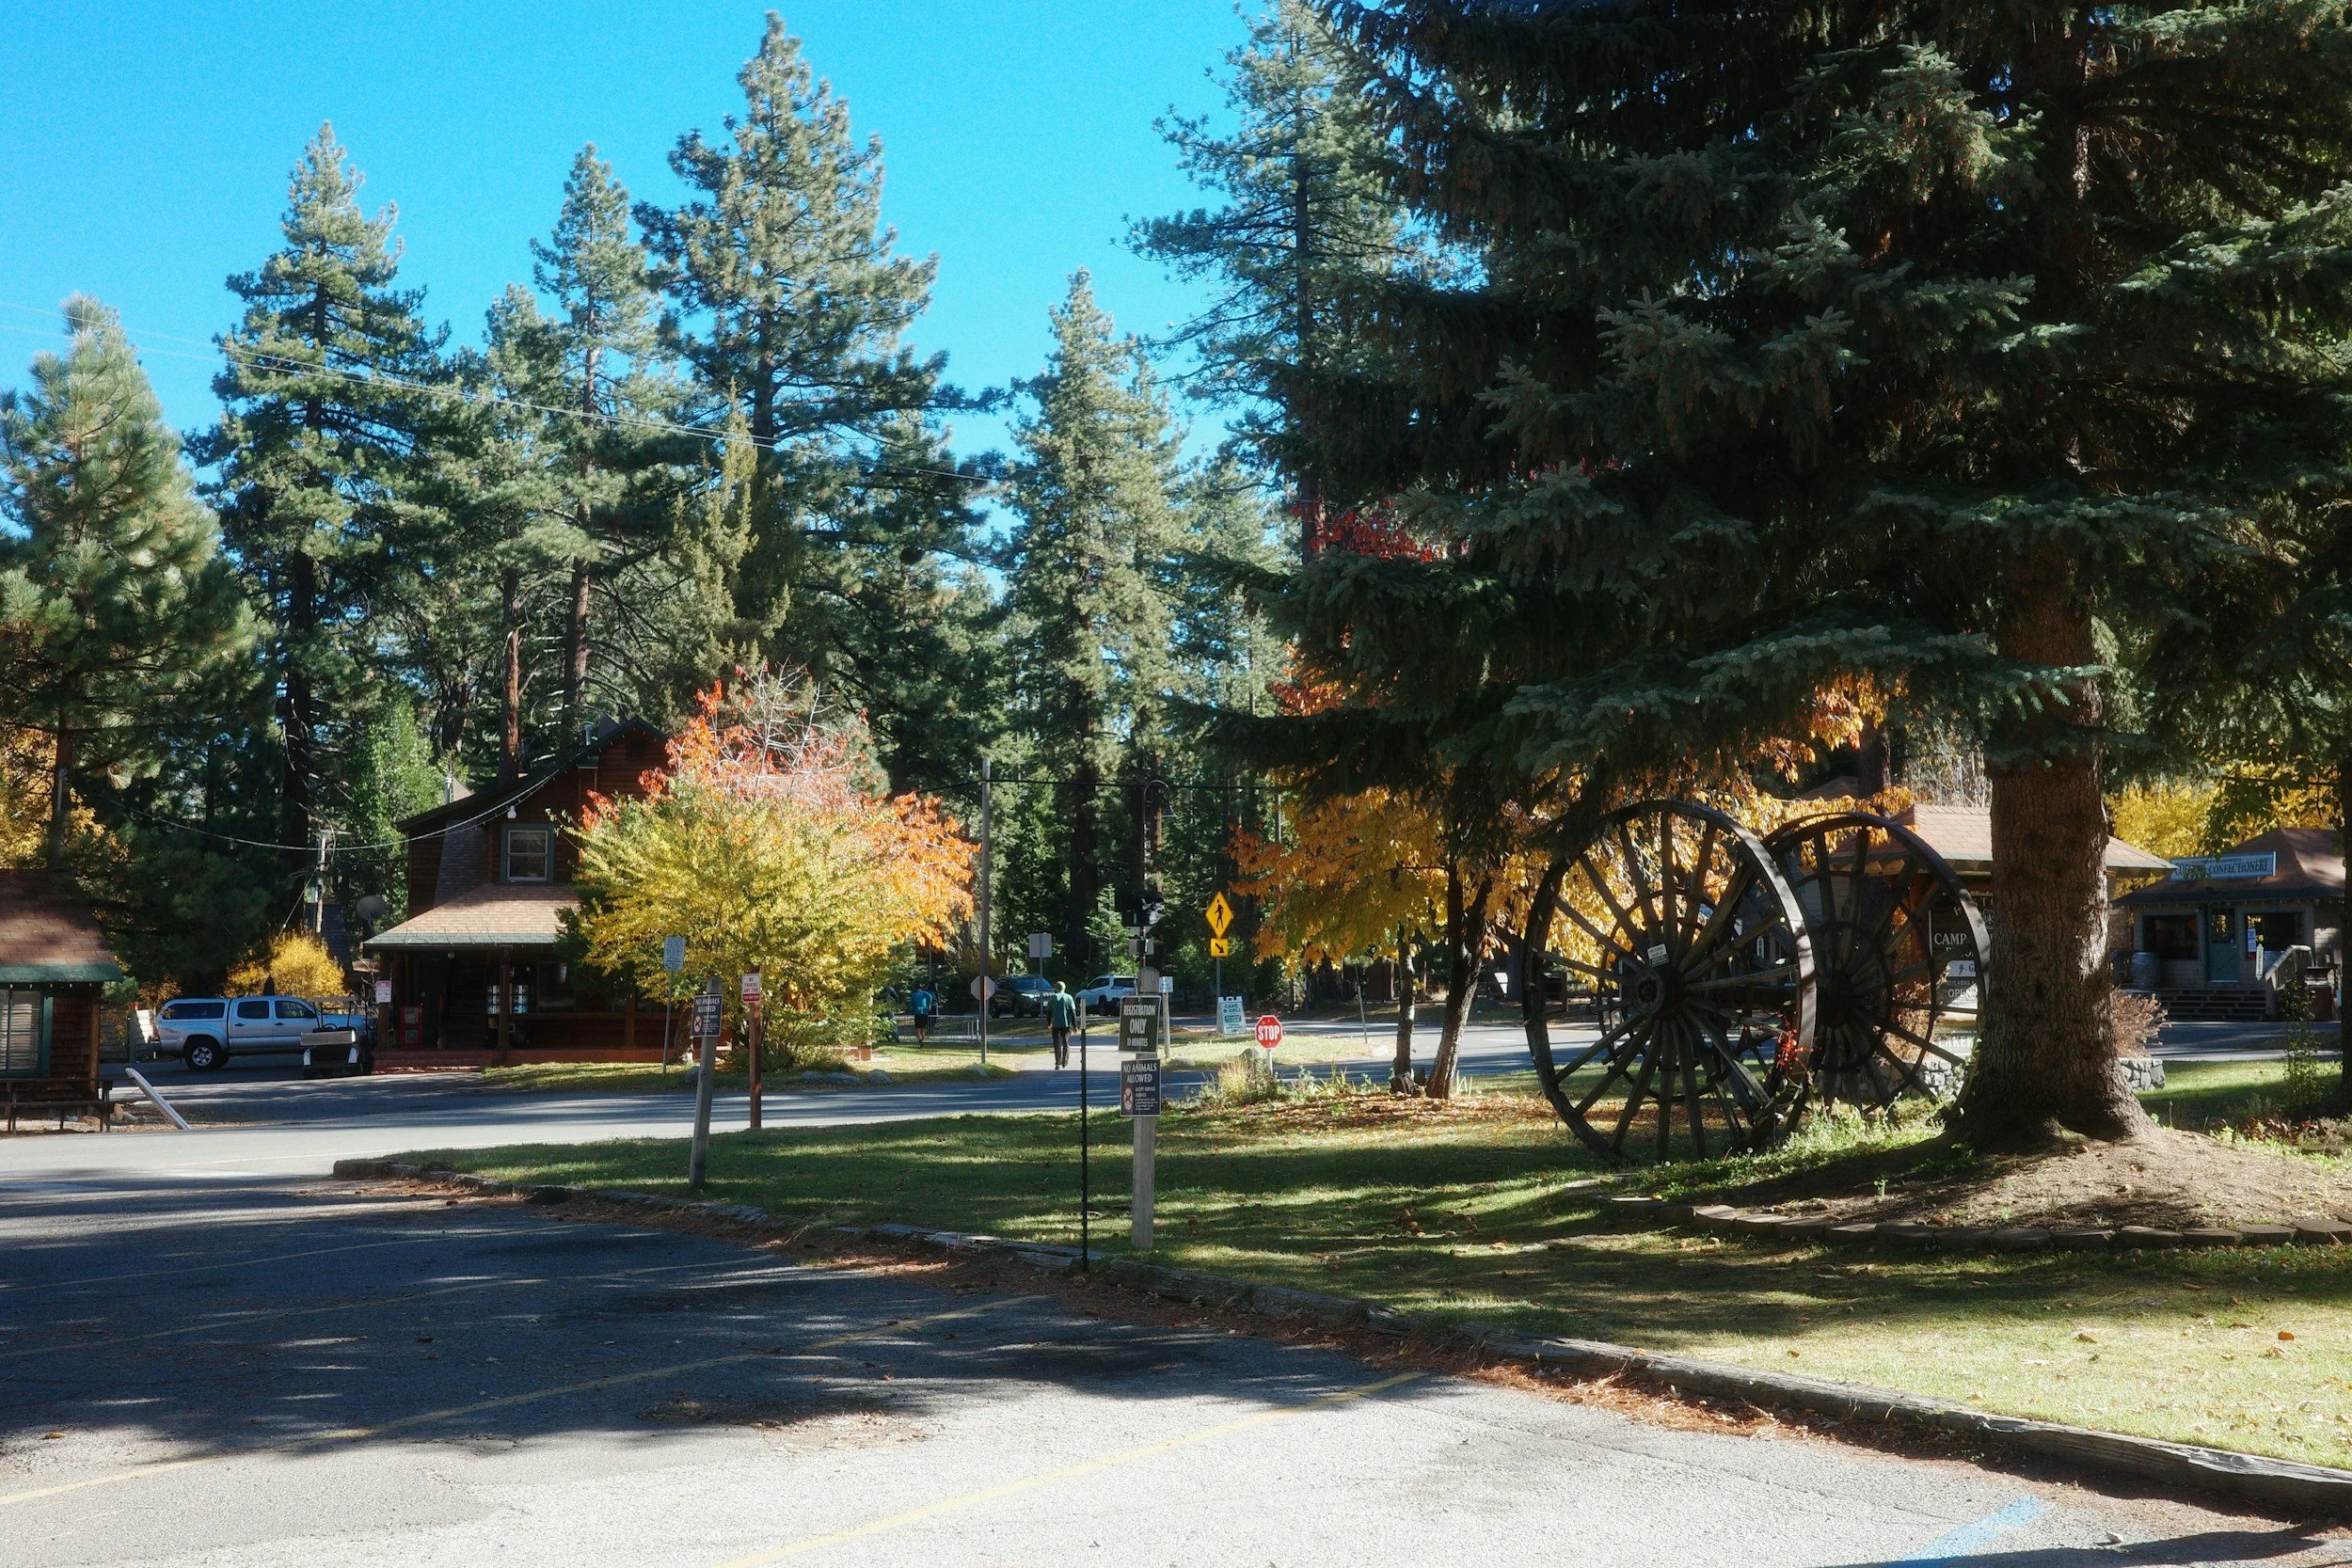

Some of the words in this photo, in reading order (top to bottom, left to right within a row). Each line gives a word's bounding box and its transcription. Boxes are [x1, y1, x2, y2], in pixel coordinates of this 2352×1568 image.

[2209, 858, 2269, 875] CONFECTIONERY
[1933, 932, 1967, 945] CAMP
[1123, 1005, 1156, 1016] REGISTRATION
[1129, 1019, 1147, 1035] ONLY
[1258, 1024, 1280, 1041] STOP
[1132, 1037, 1149, 1047] MINUTES
[1122, 1065, 1132, 1073] NO
[1132, 1063, 1158, 1073] ANIMALS
[1126, 1074, 1153, 1084] ALLOWED
